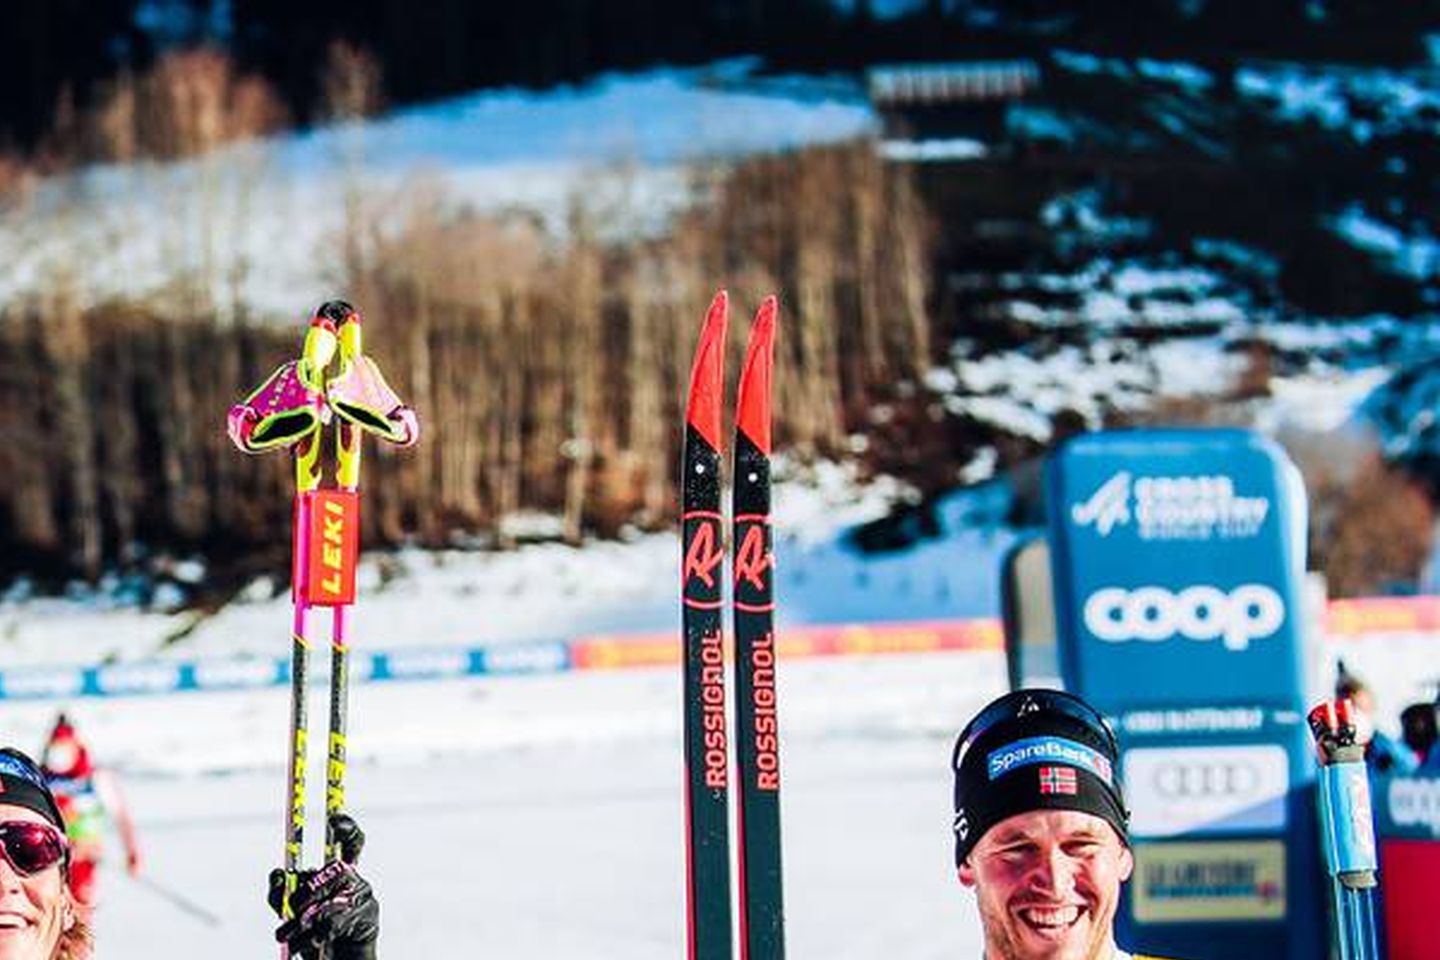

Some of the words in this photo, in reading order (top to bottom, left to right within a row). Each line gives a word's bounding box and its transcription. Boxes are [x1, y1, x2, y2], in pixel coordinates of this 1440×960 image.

[321, 500, 345, 595] LEKI
[1084, 583, 1286, 650] coop
[702, 629, 728, 789] ROSSIGNOL
[753, 632, 780, 792] ROSSIGNOL
[327, 731, 347, 811] LEK
